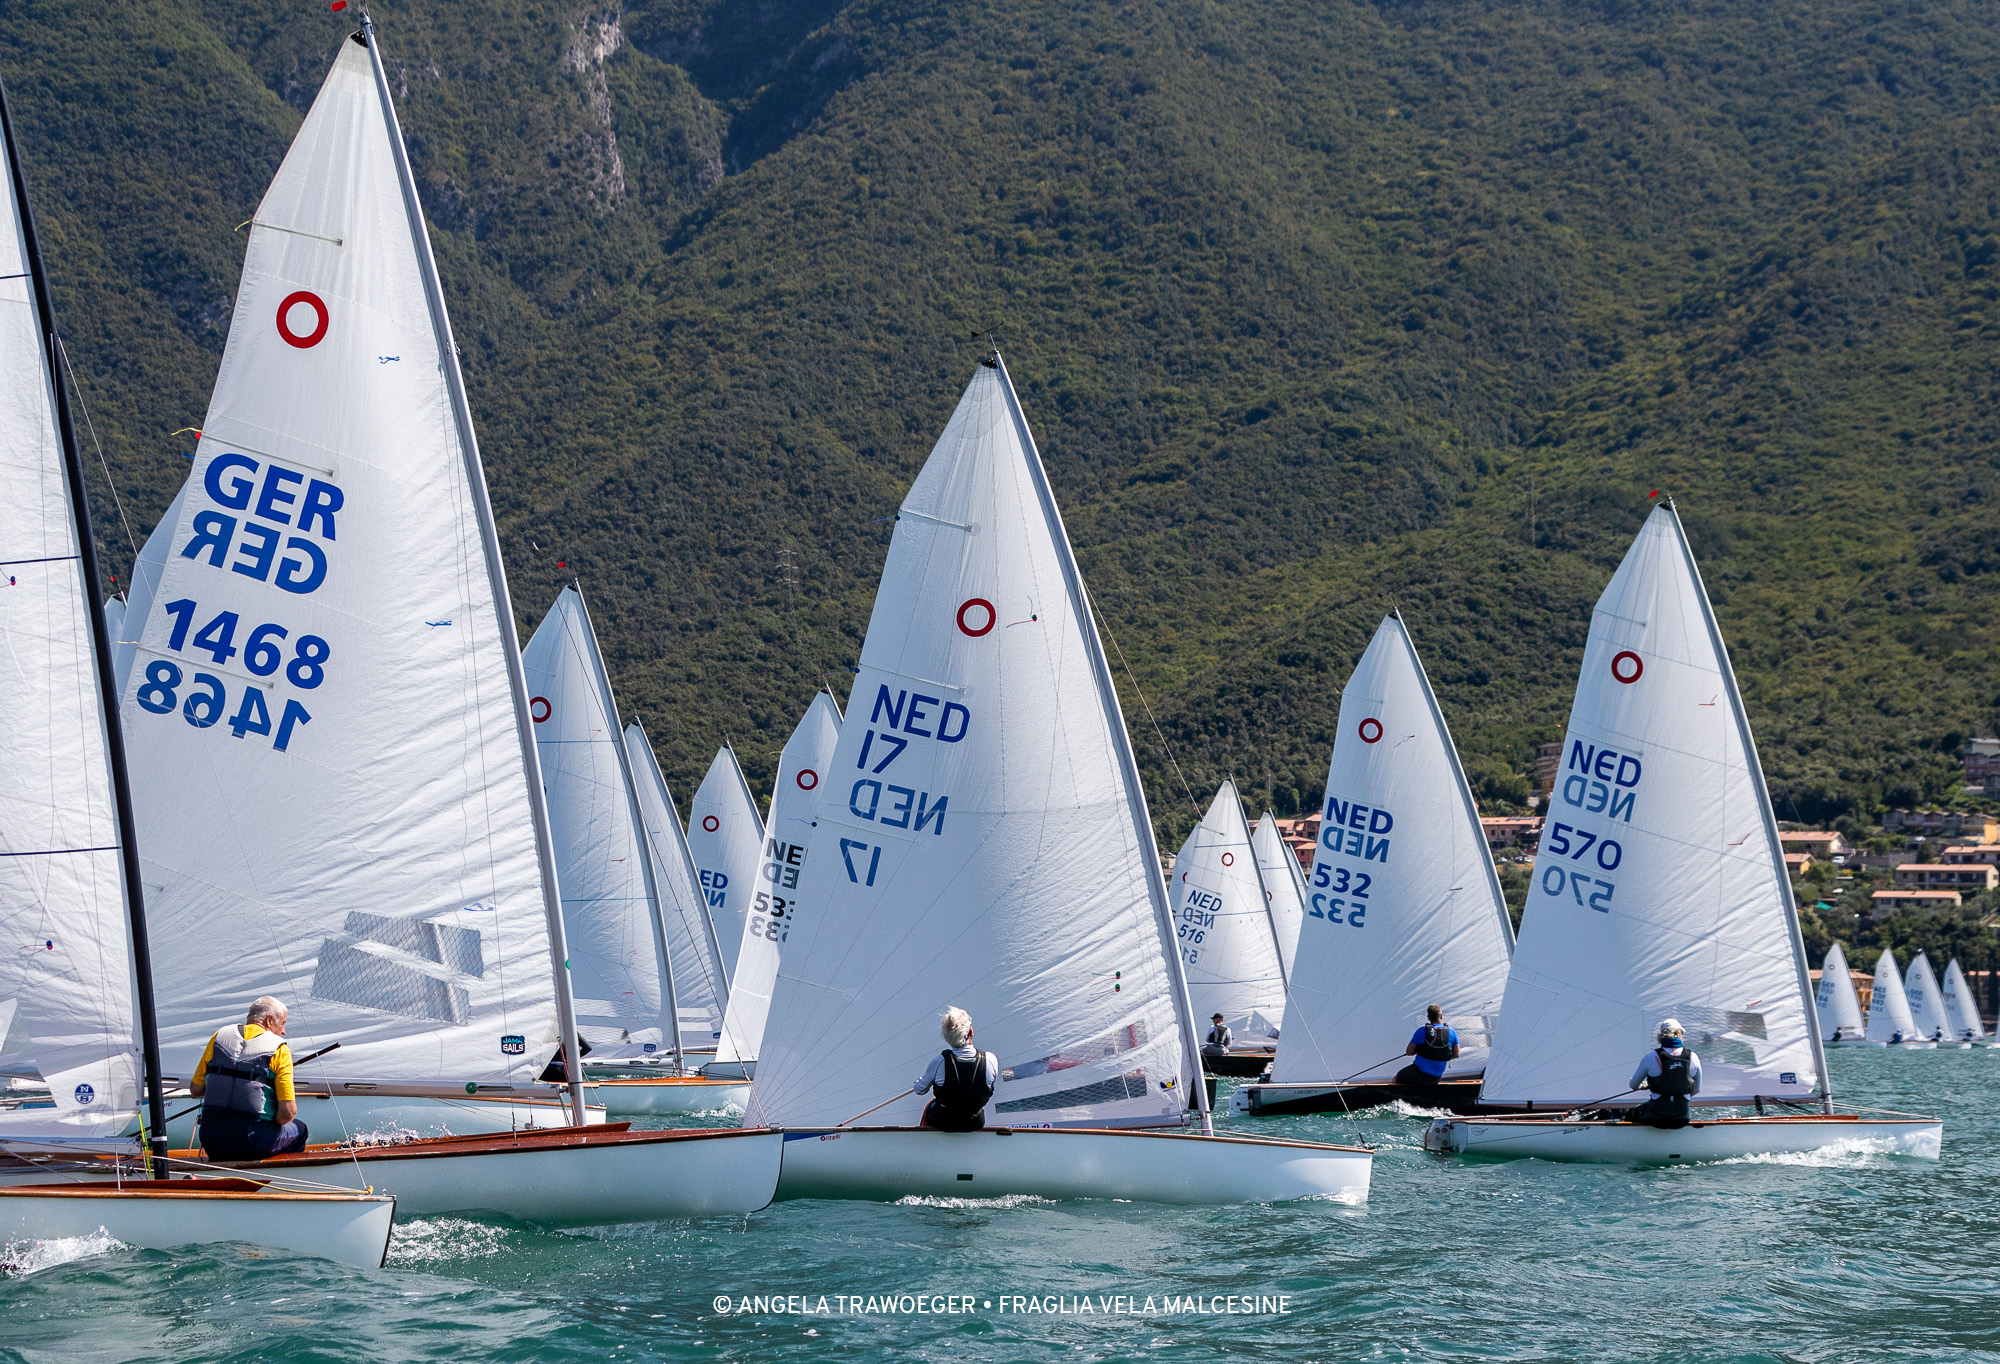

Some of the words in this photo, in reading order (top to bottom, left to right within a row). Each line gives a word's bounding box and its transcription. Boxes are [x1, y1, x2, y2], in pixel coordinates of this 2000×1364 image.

[204, 453, 344, 541] GER
[165, 598, 330, 690] 1468
[870, 684, 971, 743] NED
[857, 729, 908, 774] 17
[1568, 739, 1642, 788] NED
[1326, 796, 1394, 835] NED
[766, 837, 808, 868] NE
[1548, 822, 1622, 871] 570
[1187, 889, 1223, 912] NED
[1313, 862, 1372, 899] 532
[1178, 923, 1205, 944] 516
[502, 1043, 524, 1053] SAILS
